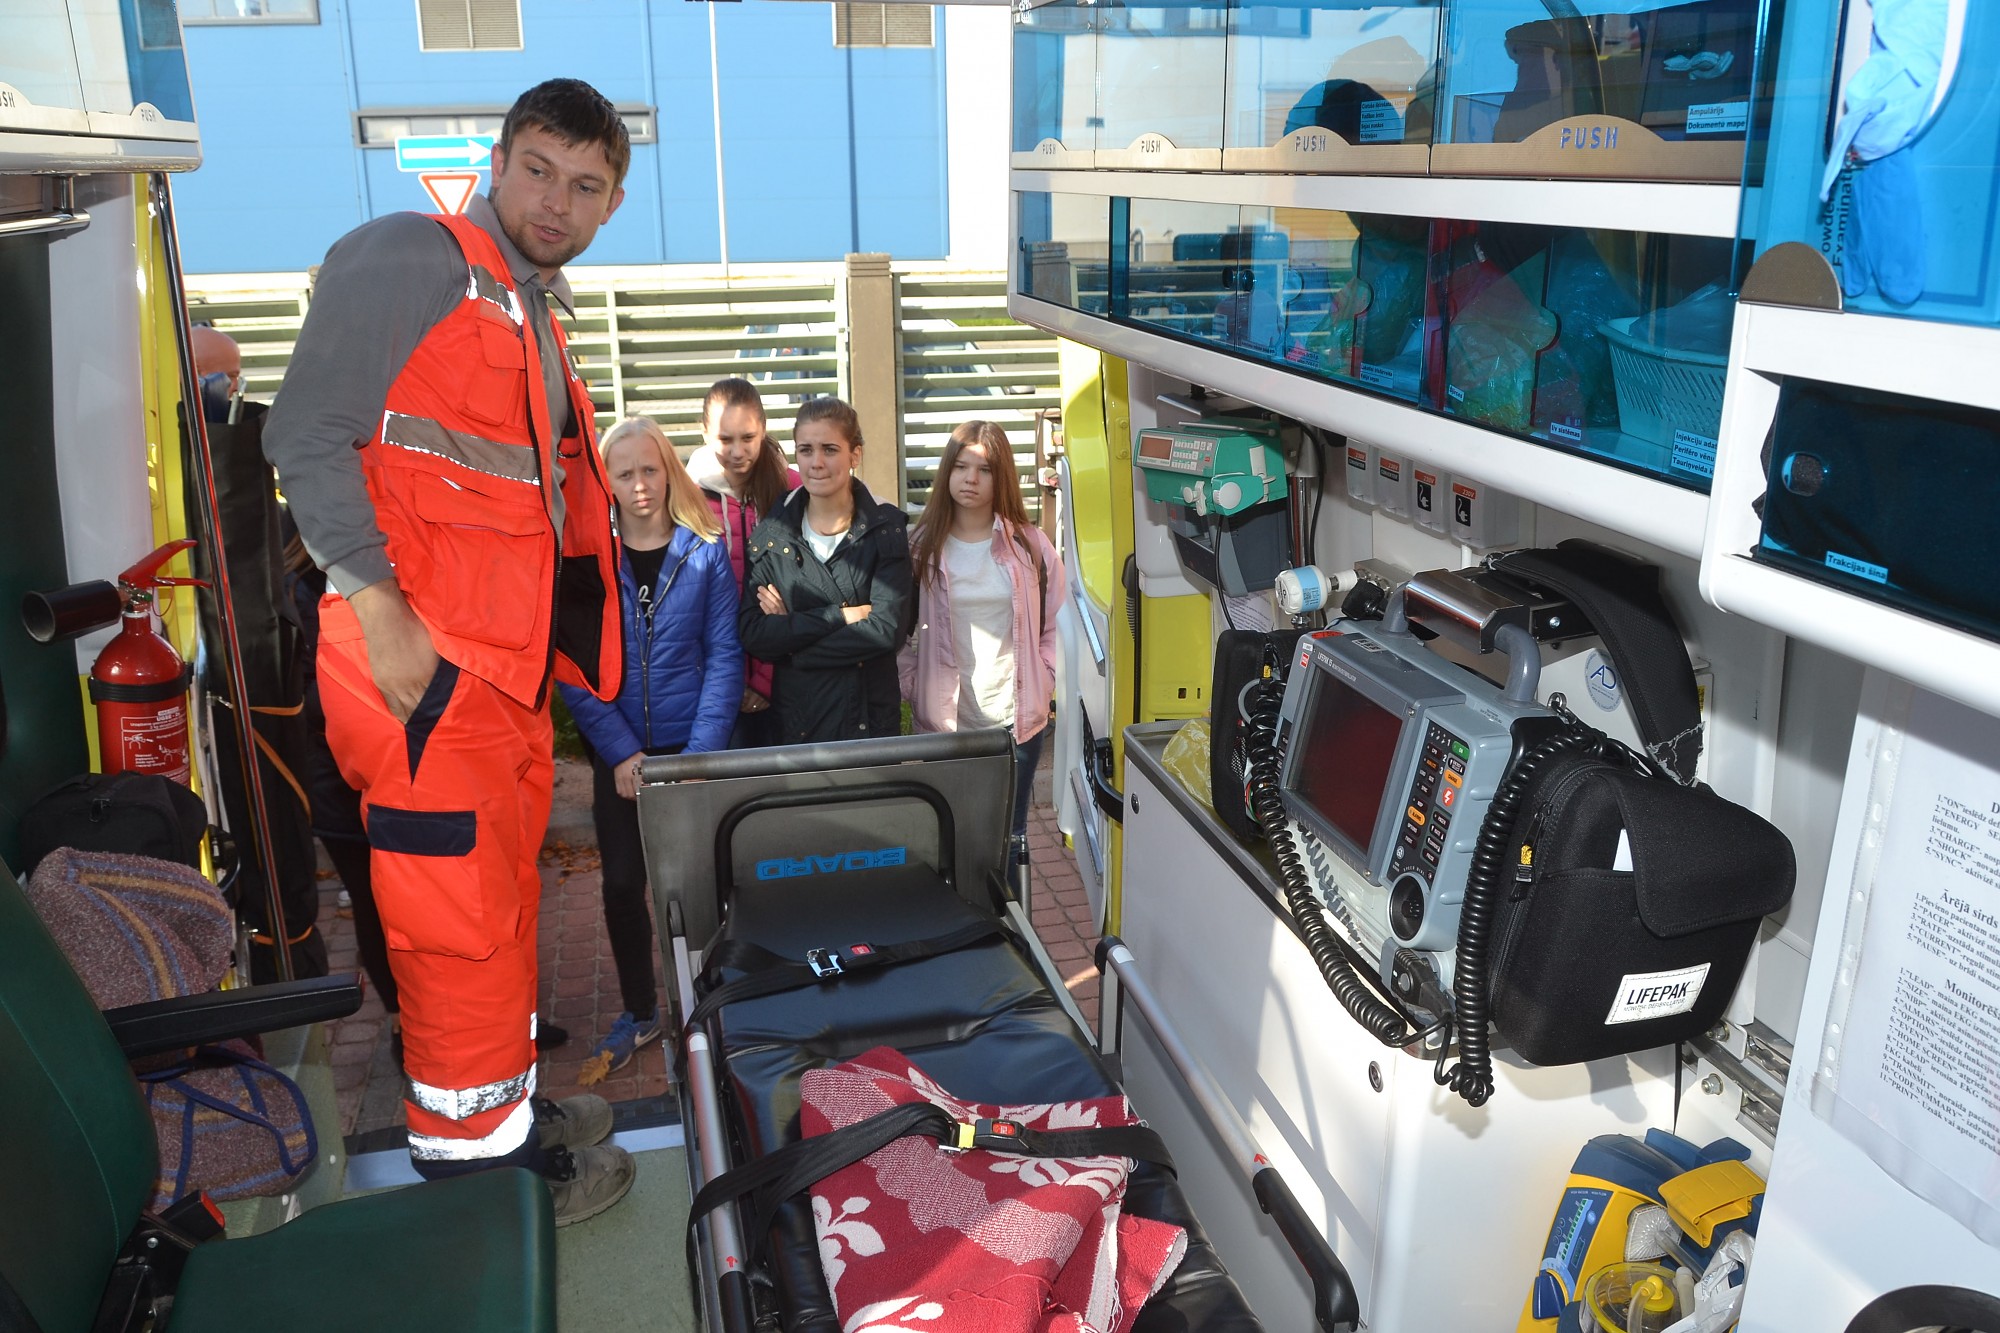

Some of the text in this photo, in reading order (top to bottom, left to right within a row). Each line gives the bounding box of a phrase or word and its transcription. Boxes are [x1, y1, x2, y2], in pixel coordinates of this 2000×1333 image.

[141, 108, 157, 122] PUSH
[1689, 107, 1725, 116] Ampulārijs
[1726, 120, 1746, 129] mape
[1141, 140, 1161, 153] PUSH
[1295, 135, 1326, 152] PUSH
[1560, 127, 1619, 149] PUSH
[1042, 143, 1056, 155] PUSH
[1558, 427, 1580, 438] sistēmas
[1675, 431, 1702, 446] Injekciju
[1674, 444, 1699, 458] Perifēro
[1673, 456, 1708, 474] Tauriņveida
[1423, 475, 1435, 484] 230V
[1463, 488, 1475, 498] 230V
[1828, 555, 1886, 578] Trakcijas šina
[1447, 738, 1451, 747] 1
[1442, 754, 1447, 762] 2
[1439, 766, 1444, 775] 3
[1932, 815, 1960, 834] lielumu.
[755, 847, 907, 881] BOARD
[1940, 888, 1999, 929] Ārējā sirds
[1950, 913, 1987, 937] pacientam
[1949, 958, 1958, 966] uz
[1959, 963, 1977, 978] brīdi
[1626, 981, 1691, 1006] LIFEPAK
[1931, 999, 1952, 1015] maina
[1953, 1011, 1972, 1027] EKG
[1937, 991, 1959, 1008] maina
[1960, 1004, 1979, 1019] EKG
[1884, 1043, 1901, 1059] EKG
[1957, 1058, 1988, 1082] lietotāja
[1963, 1051, 1995, 1075] funkciju
[1930, 1064, 1958, 1086] ierosina
[1959, 1082, 1980, 1099] EKG
[1938, 1092, 1967, 1113] noraida
[1921, 1101, 1943, 1120] Uzsāk
[1943, 1116, 1955, 1127] vai
[1956, 1125, 1977, 1141] aptur
